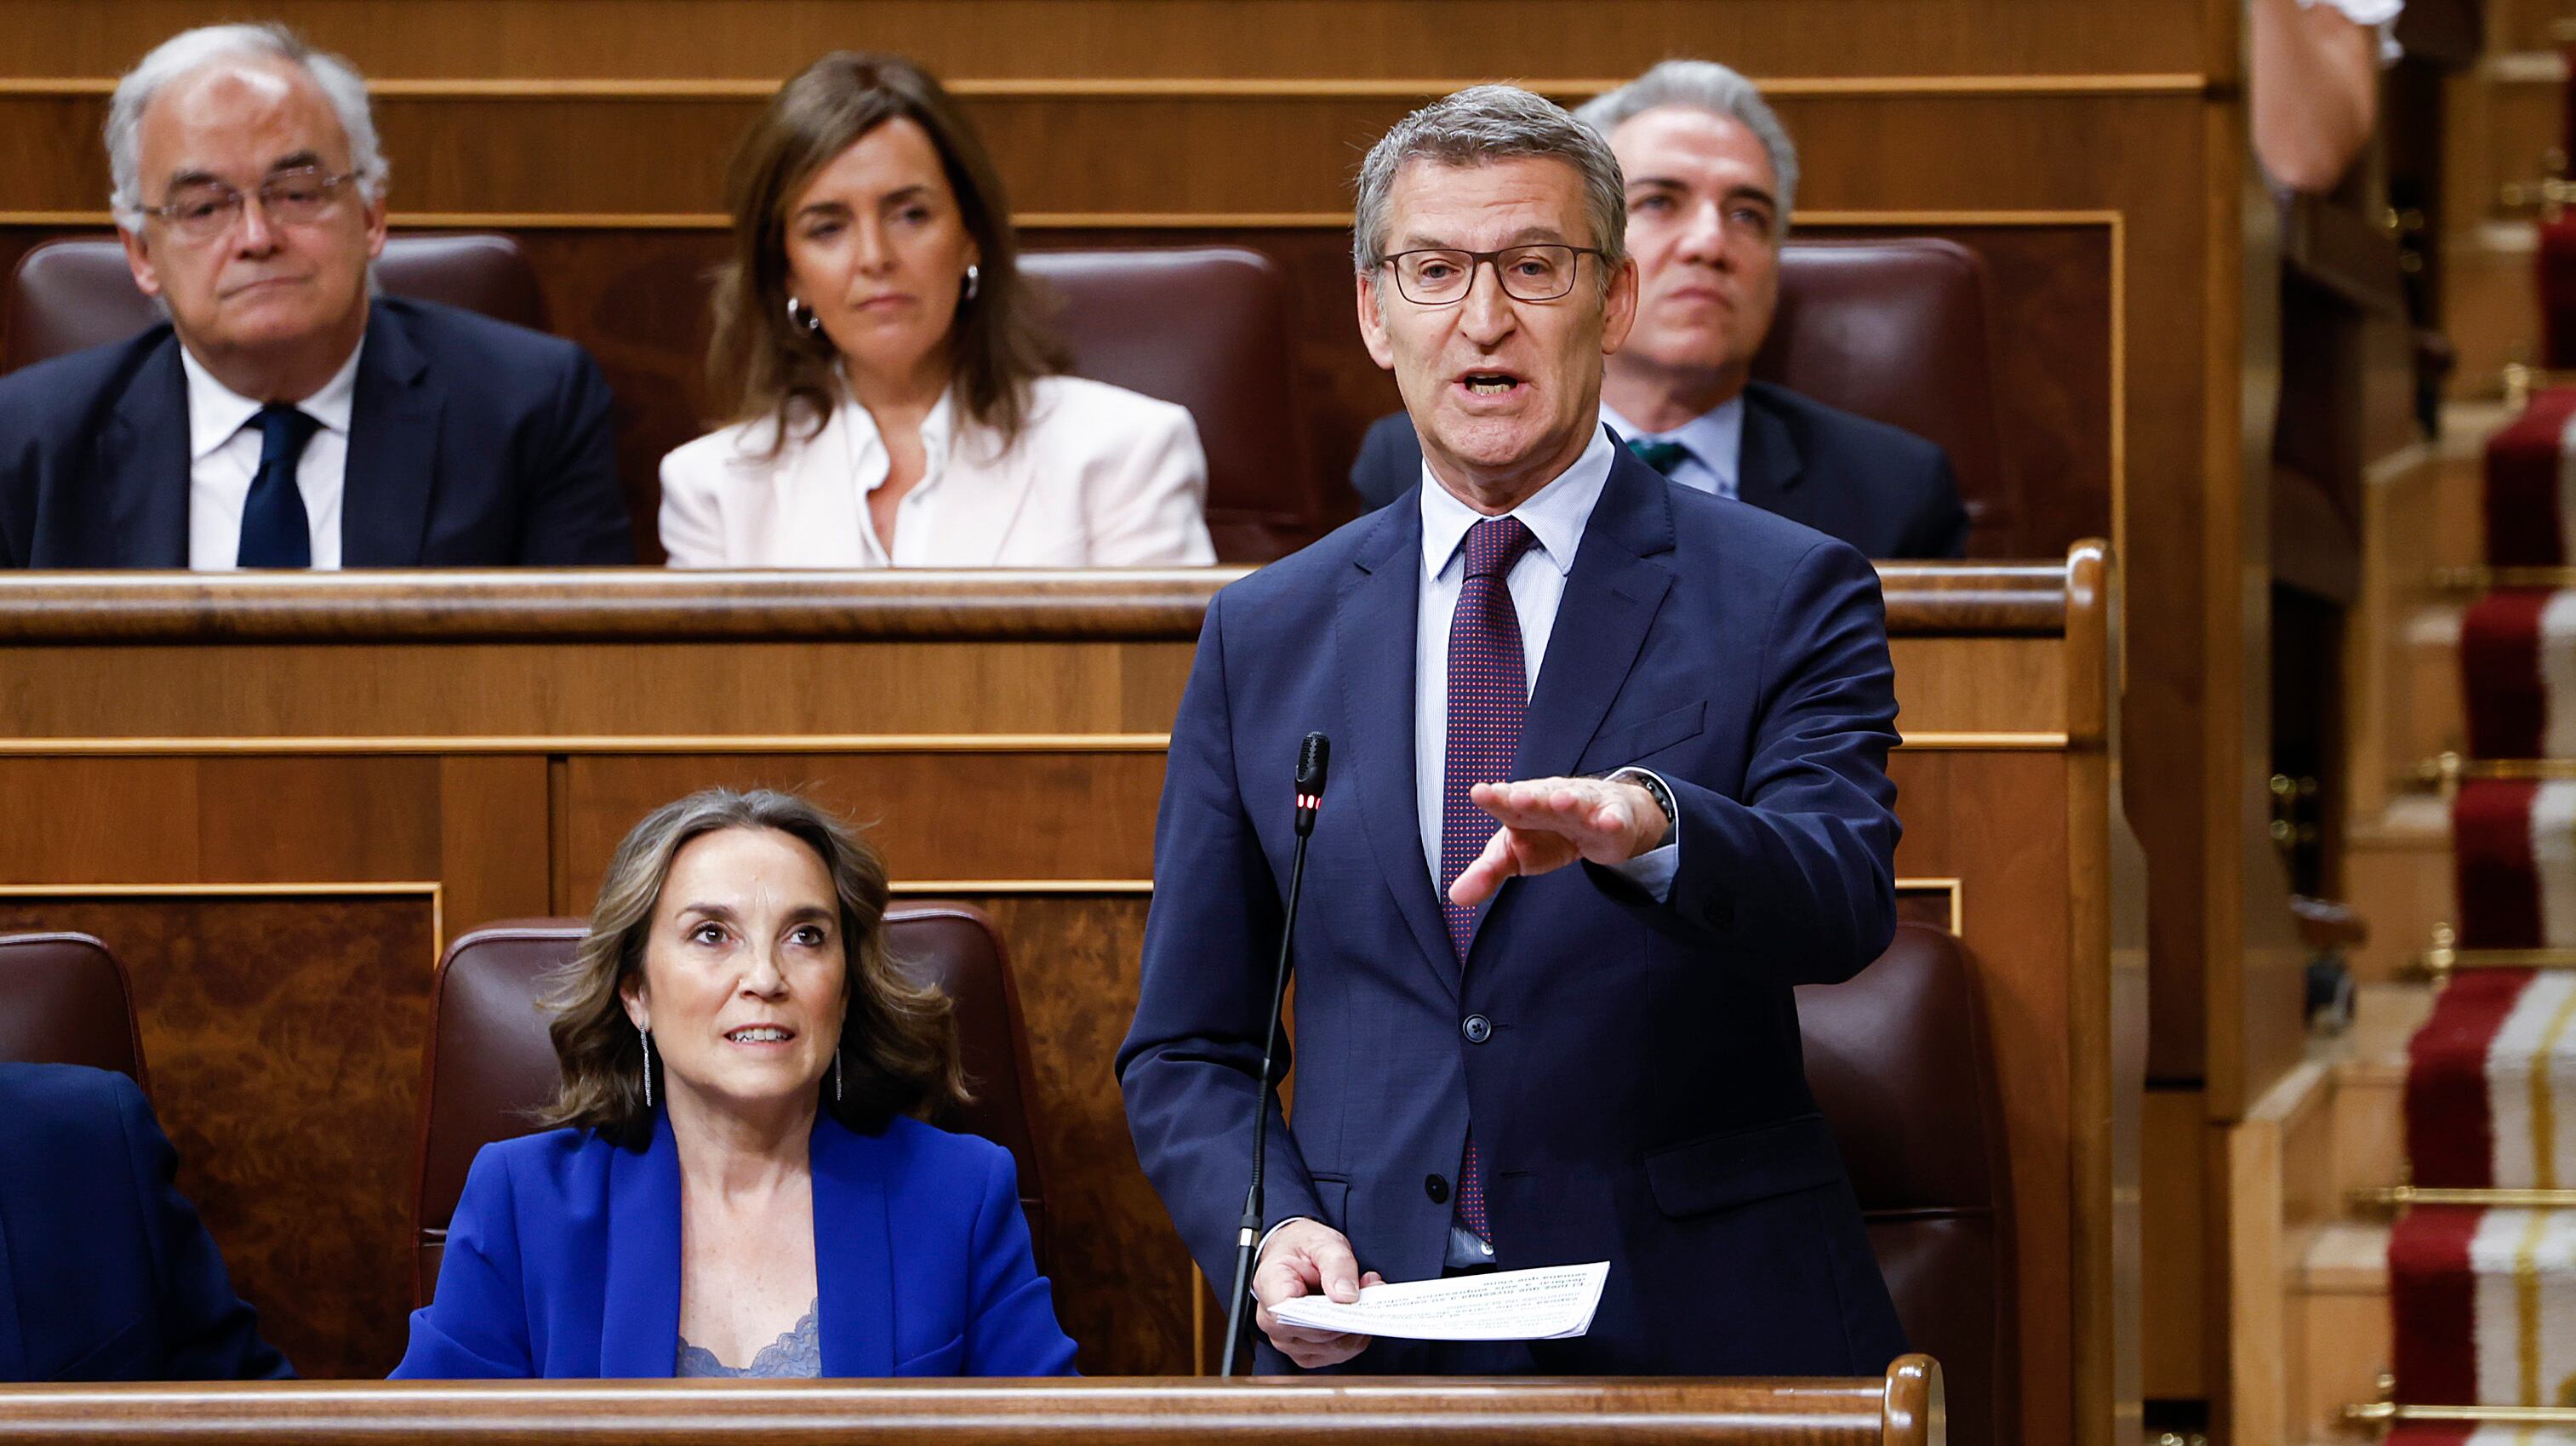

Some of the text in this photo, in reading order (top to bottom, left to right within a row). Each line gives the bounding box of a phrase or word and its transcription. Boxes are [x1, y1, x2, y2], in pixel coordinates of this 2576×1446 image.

[1543, 1272, 1587, 1281] semana
[1540, 1277, 1586, 1287] declarar
[1416, 1288, 1488, 1300] empresarios
[1462, 1290, 1514, 1300] investiga
[1386, 1300, 1427, 1308] esposa
